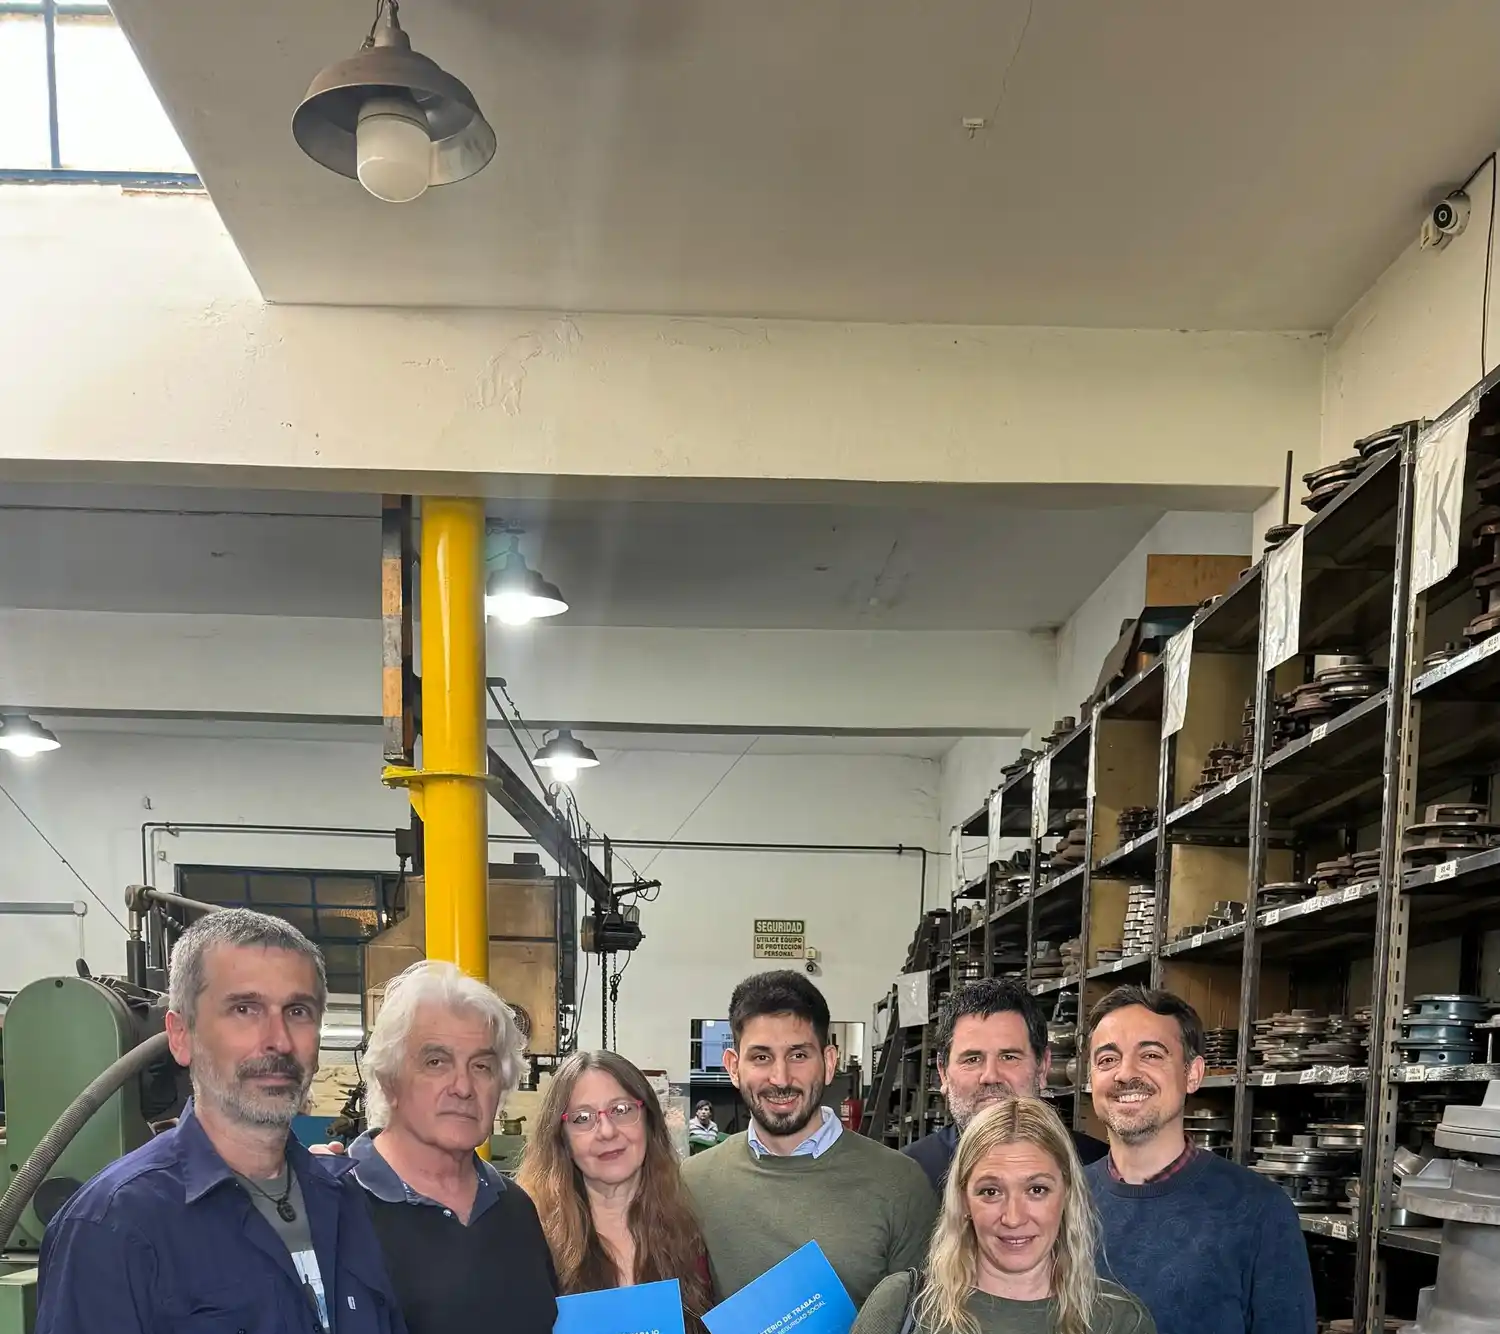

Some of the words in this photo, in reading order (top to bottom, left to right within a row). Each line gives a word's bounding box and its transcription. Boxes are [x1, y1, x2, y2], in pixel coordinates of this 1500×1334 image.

[1430, 457, 1459, 560] K
[756, 921, 803, 933] SEGURIDAD
[807, 1300, 827, 1316] SOCIAL
[782, 1313, 792, 1323] DE
